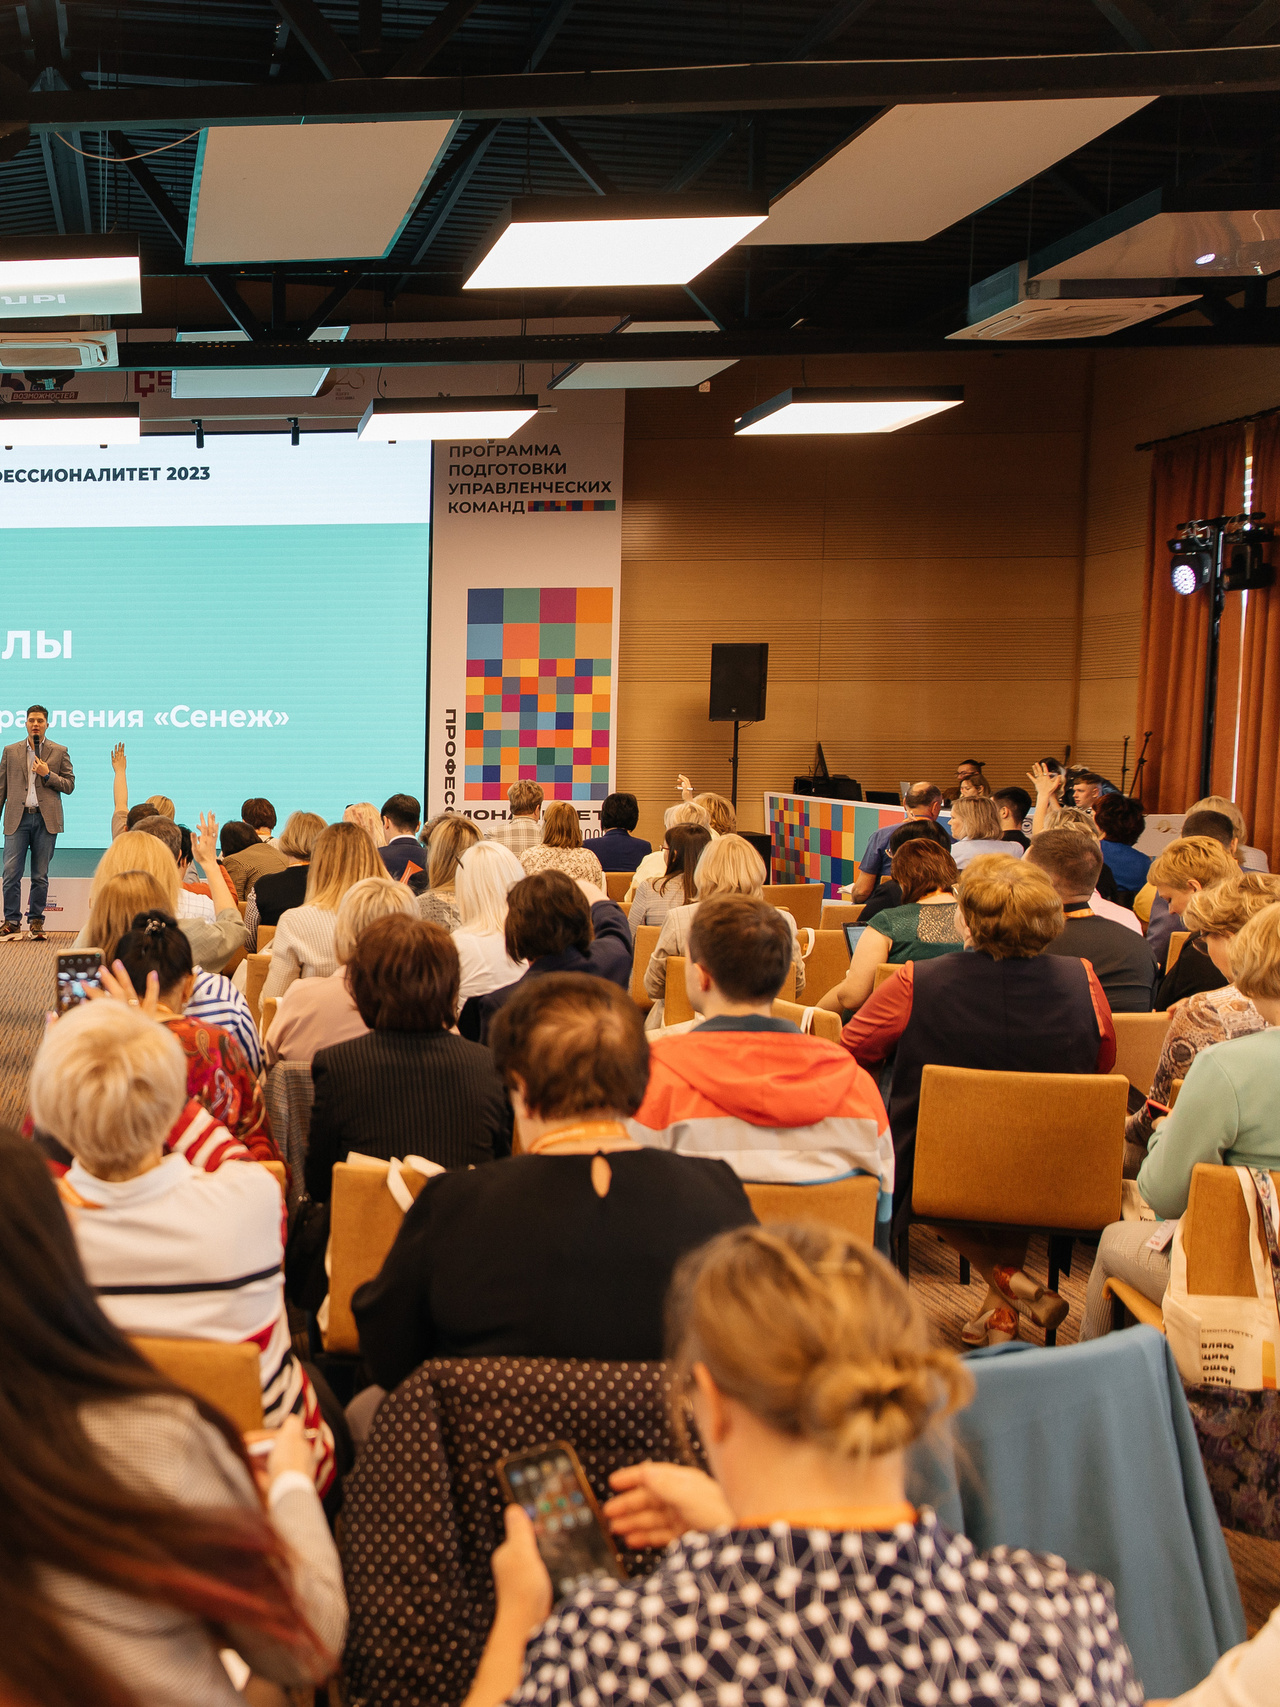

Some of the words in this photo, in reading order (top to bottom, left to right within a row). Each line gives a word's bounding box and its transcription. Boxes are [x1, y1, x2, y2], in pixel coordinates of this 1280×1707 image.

[12, 391, 76, 400] ВОЗМОЖНОСТЕЙ
[449, 444, 562, 458] ПРОГРАММА
[166, 467, 211, 481] 2023
[449, 463, 567, 478] ПОДГОТОВКИ
[448, 481, 612, 495] УПРАВЛЕНЧЕСКИХ
[448, 500, 526, 515] КОМАНД
[153, 704, 291, 729] «Сенеж»
